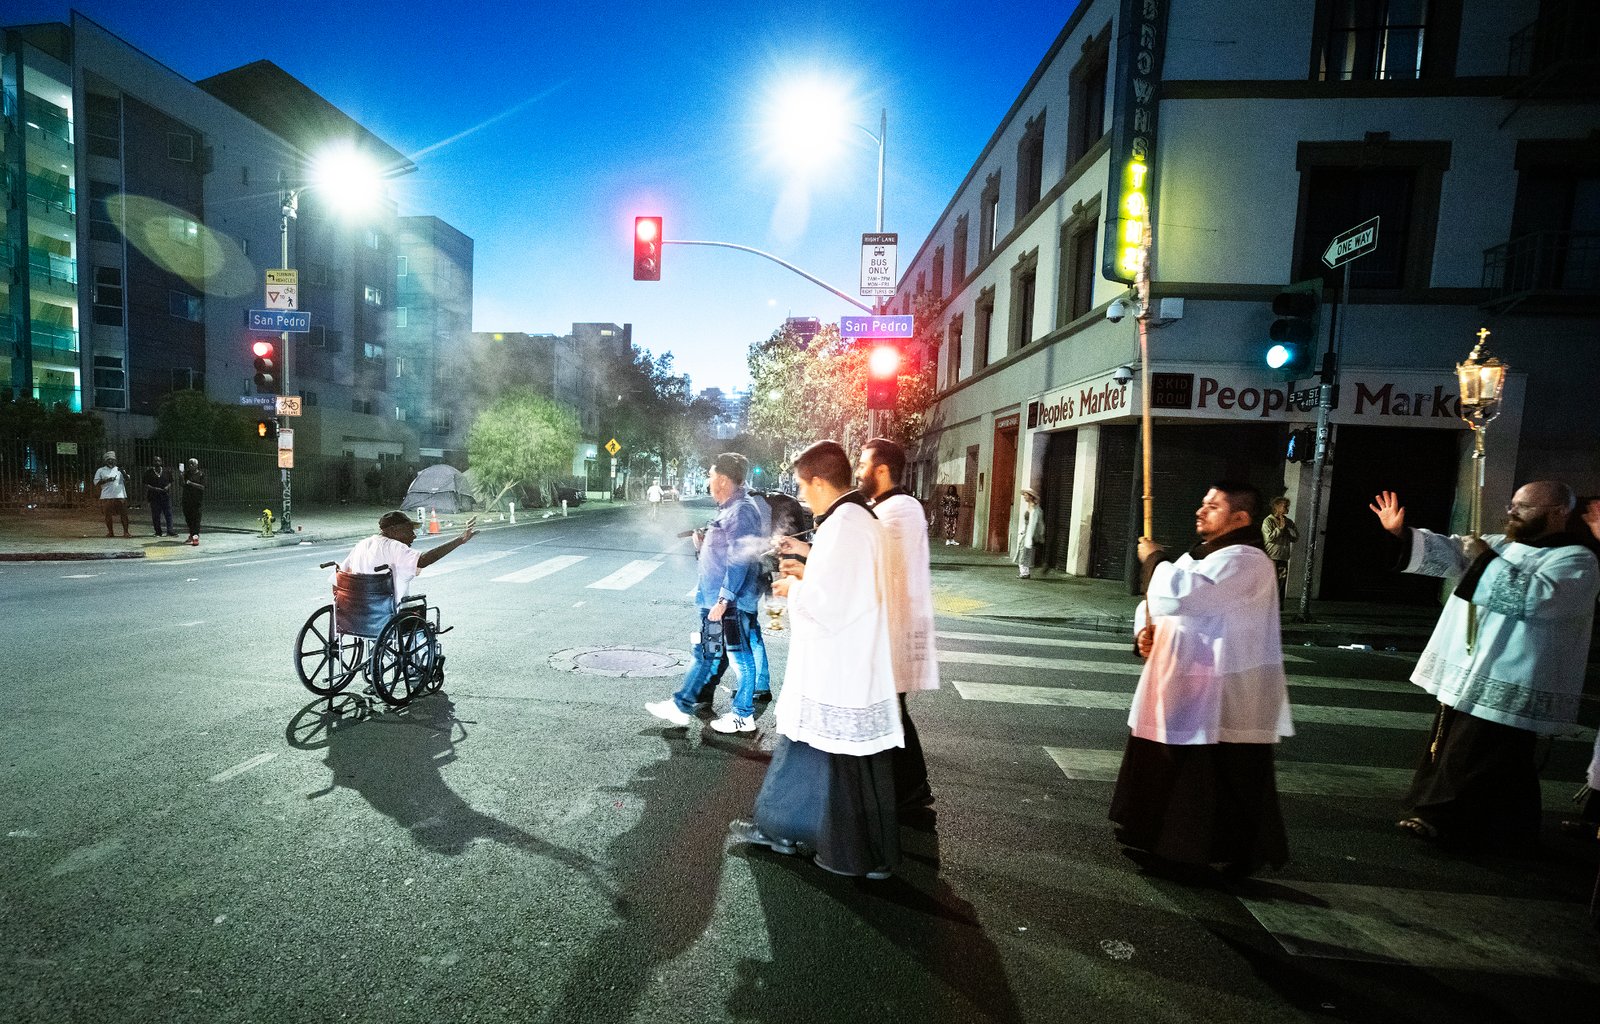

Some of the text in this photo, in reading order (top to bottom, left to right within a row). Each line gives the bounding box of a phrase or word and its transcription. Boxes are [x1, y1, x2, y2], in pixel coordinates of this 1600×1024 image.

[1337, 229, 1372, 255] ONE WAY
[870, 258, 887, 266] BUS
[868, 266, 889, 275] ONLY
[254, 314, 306, 327] San Pedro
[845, 320, 908, 332] San Pedro
[1156, 377, 1189, 390] SKID
[241, 396, 253, 404] San
[1038, 396, 1075, 427] People's
[1079, 381, 1127, 417] Market
[1156, 392, 1187, 405] ROW
